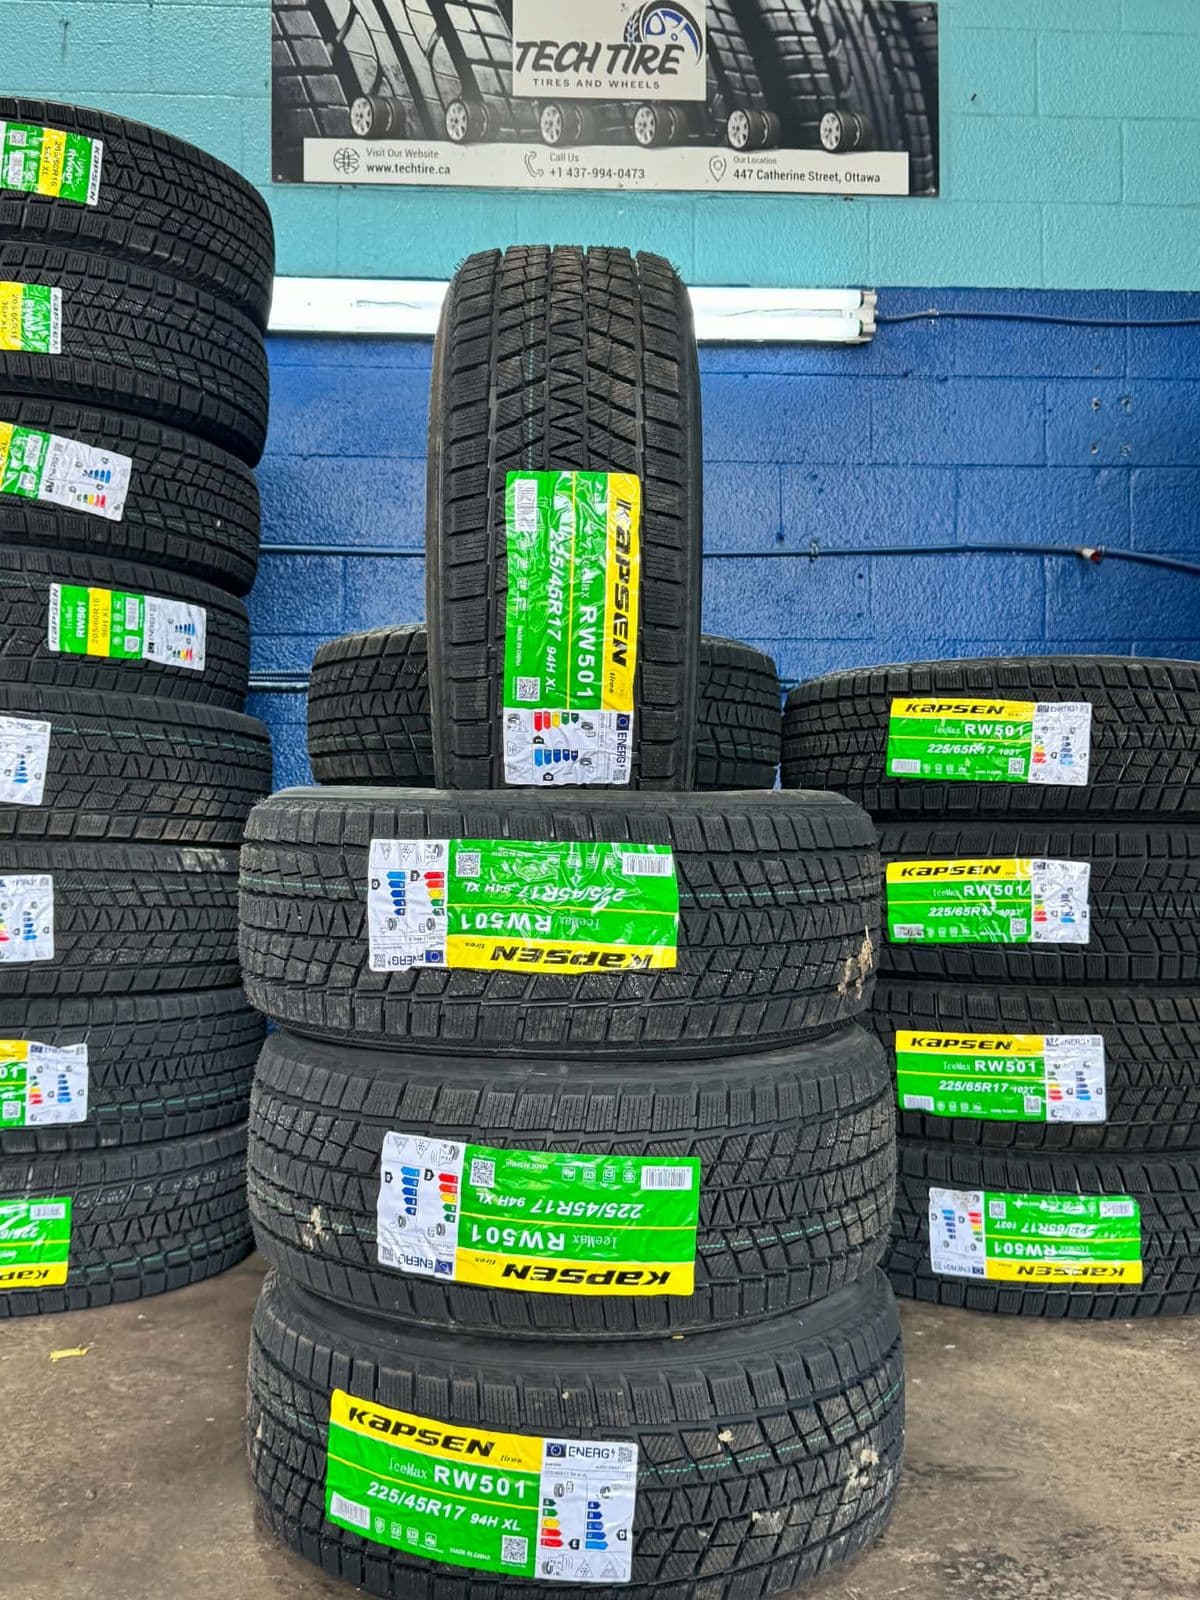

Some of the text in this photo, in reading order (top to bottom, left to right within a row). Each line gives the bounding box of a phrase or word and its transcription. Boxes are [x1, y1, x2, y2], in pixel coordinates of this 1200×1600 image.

[514, 40, 685, 75] TECH TIRE
[533, 78, 661, 89] TIRES AND WHEELS
[367, 148, 439, 159] Visit Our Website
[550, 152, 579, 163] Call Us
[733, 156, 777, 165] Our Location
[366, 163, 451, 175] www.techtire.ca
[549, 167, 645, 180] +1 437-994-0473
[733, 169, 881, 184] 447 Catherine Street, Ottawa
[545, 528, 570, 693] 225/45R17 94H XL
[76, 601, 86, 638] RW501
[576, 606, 597, 697] RW501
[964, 723, 1024, 737] RW501
[927, 743, 995, 755] 225/65R17
[463, 881, 623, 903] 225/45R17 94H XL
[964, 885, 1022, 897] RW501
[461, 912, 552, 934] RW501
[974, 1060, 1036, 1073] RW501
[938, 1079, 1035, 1095] 225/65R17 102T
[475, 1191, 645, 1220] 225/45R17 94H XL
[994, 1220, 1017, 1230] 102T
[471, 1224, 565, 1251] RW501
[994, 1241, 1057, 1257] RW501
[474, 1257, 496, 1265] tires
[500, 1454, 523, 1464] tires
[568, 1446, 610, 1460] ENERG
[389, 1458, 527, 1499] IceMax RW501
[366, 1480, 521, 1532] 225/45R17 94H XL
[449, 1547, 466, 1556] MADE
[473, 1551, 491, 1560] CHINA
